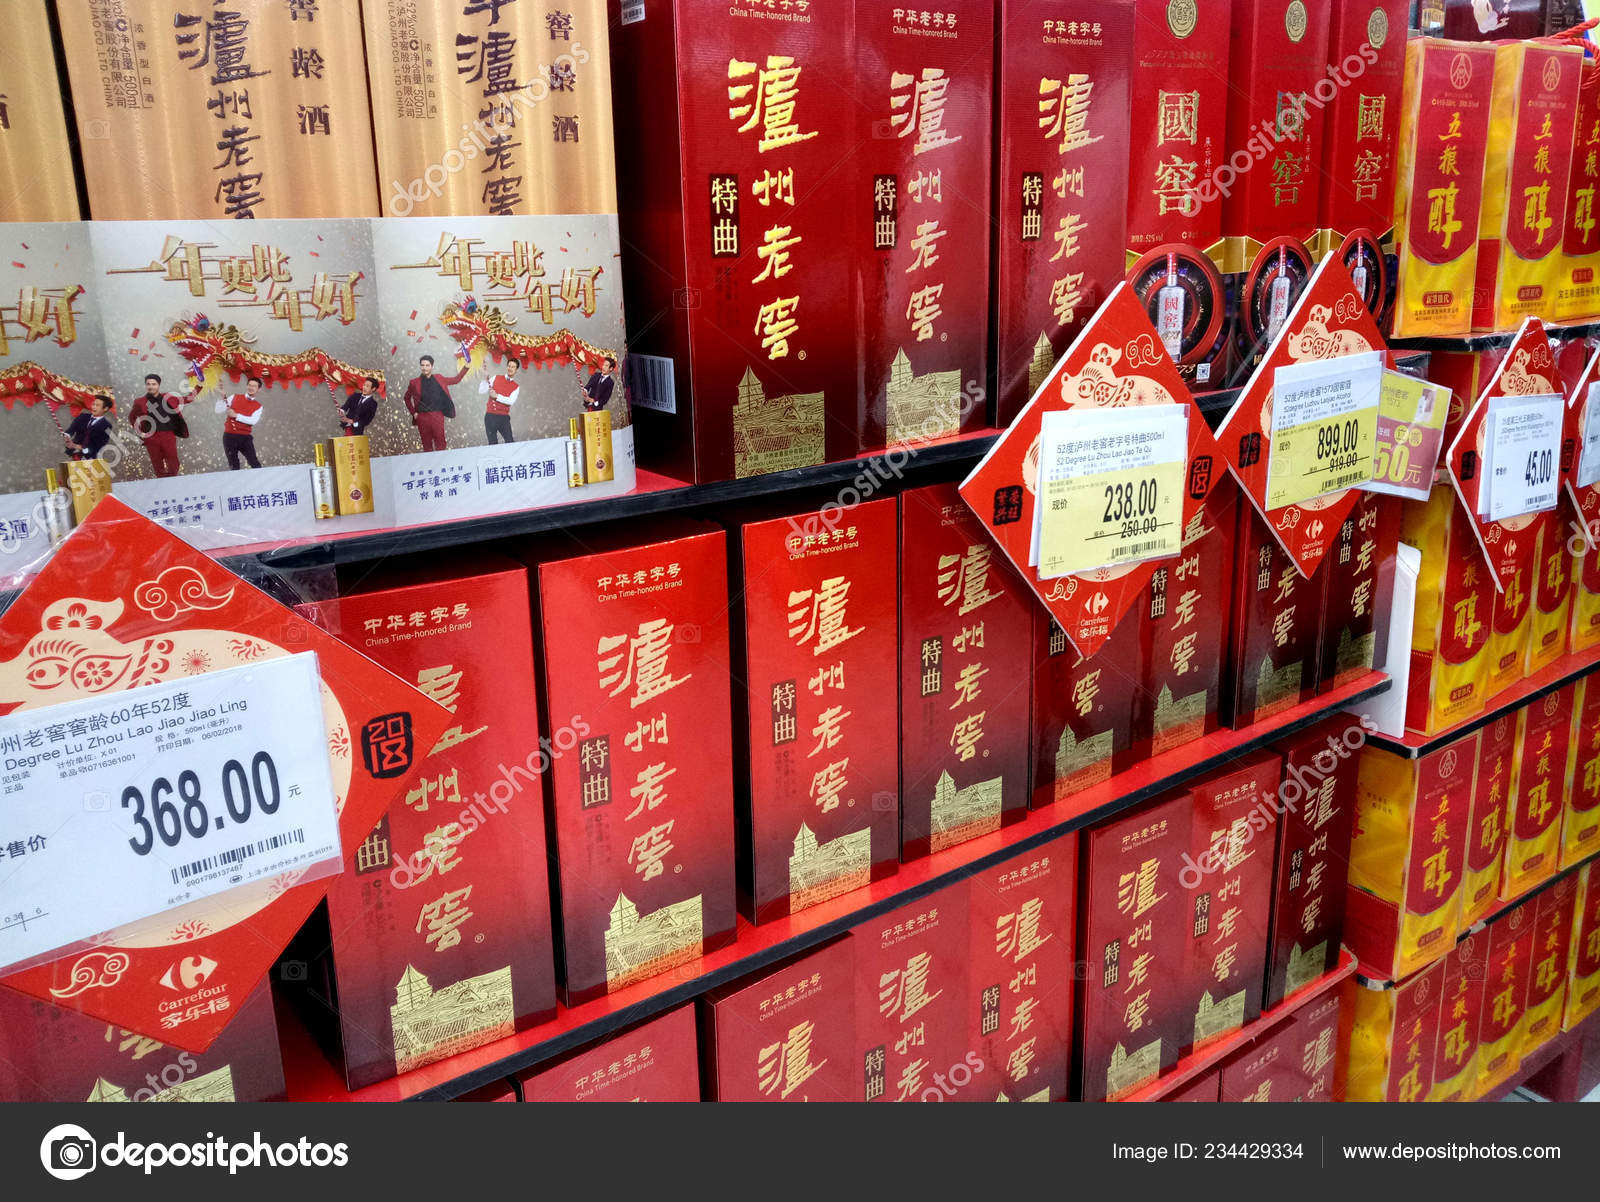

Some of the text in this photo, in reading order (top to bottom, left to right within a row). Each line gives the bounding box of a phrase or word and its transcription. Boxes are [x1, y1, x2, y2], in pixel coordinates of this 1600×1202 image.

[729, 7, 811, 24] China Time-honored Brand
[892, 8, 958, 29] 中华老字号
[1042, 20, 1103, 37] 中华老字号
[711, 178, 738, 255] 特曲
[875, 178, 896, 248] 特曲
[1022, 176, 1043, 240] 特曲
[1317, 418, 1359, 460] 899.00
[484, 459, 557, 485] 精英商务酒
[1525, 448, 1552, 487] 45.00
[227, 490, 299, 512] 精英商务酒
[1051, 499, 1068, 511] 现价
[1103, 478, 1158, 523] 238.00
[788, 525, 859, 551] 中华老字号
[1120, 516, 1158, 539] 250.00
[1339, 521, 1354, 565] 特曲
[788, 540, 860, 561] China Time-honored Brand
[597, 562, 682, 592] 中华老字号
[1257, 546, 1272, 592] 特曲
[597, 579, 683, 603] China Time-honored Brand
[1151, 570, 1167, 619] 特曲
[363, 603, 471, 635] 中华老字号
[365, 620, 473, 648] China Time-honored Brand
[1079, 624, 1109, 640] 家乐福
[1080, 615, 1110, 626] Carrefour
[920, 640, 943, 697] 特曲
[772, 682, 796, 745] 特曲
[5, 699, 248, 771] Degree Lu Zhou Lao Jiao Jiao Ling
[201, 723, 243, 742] 06/02/2018
[4, 782, 24, 795] 正品
[581, 739, 610, 807] 特曲
[121, 749, 302, 856] 368.00 元
[1213, 780, 1257, 803] 中华老字号
[1121, 820, 1168, 845] 中华老字号
[998, 857, 1050, 885] 中华老字号
[1289, 850, 1303, 892] 特曲
[881, 908, 938, 940] 中华老字号
[1194, 893, 1210, 937] 特曲
[1104, 941, 1120, 989] 特曲
[158, 983, 228, 1014] Carrefour
[759, 972, 822, 1012] 中华老字号
[160, 994, 231, 1030] 家乐福
[982, 986, 999, 1036] 特曲
[575, 1045, 652, 1091] 中华老字号
[865, 1048, 885, 1102] 特曲
